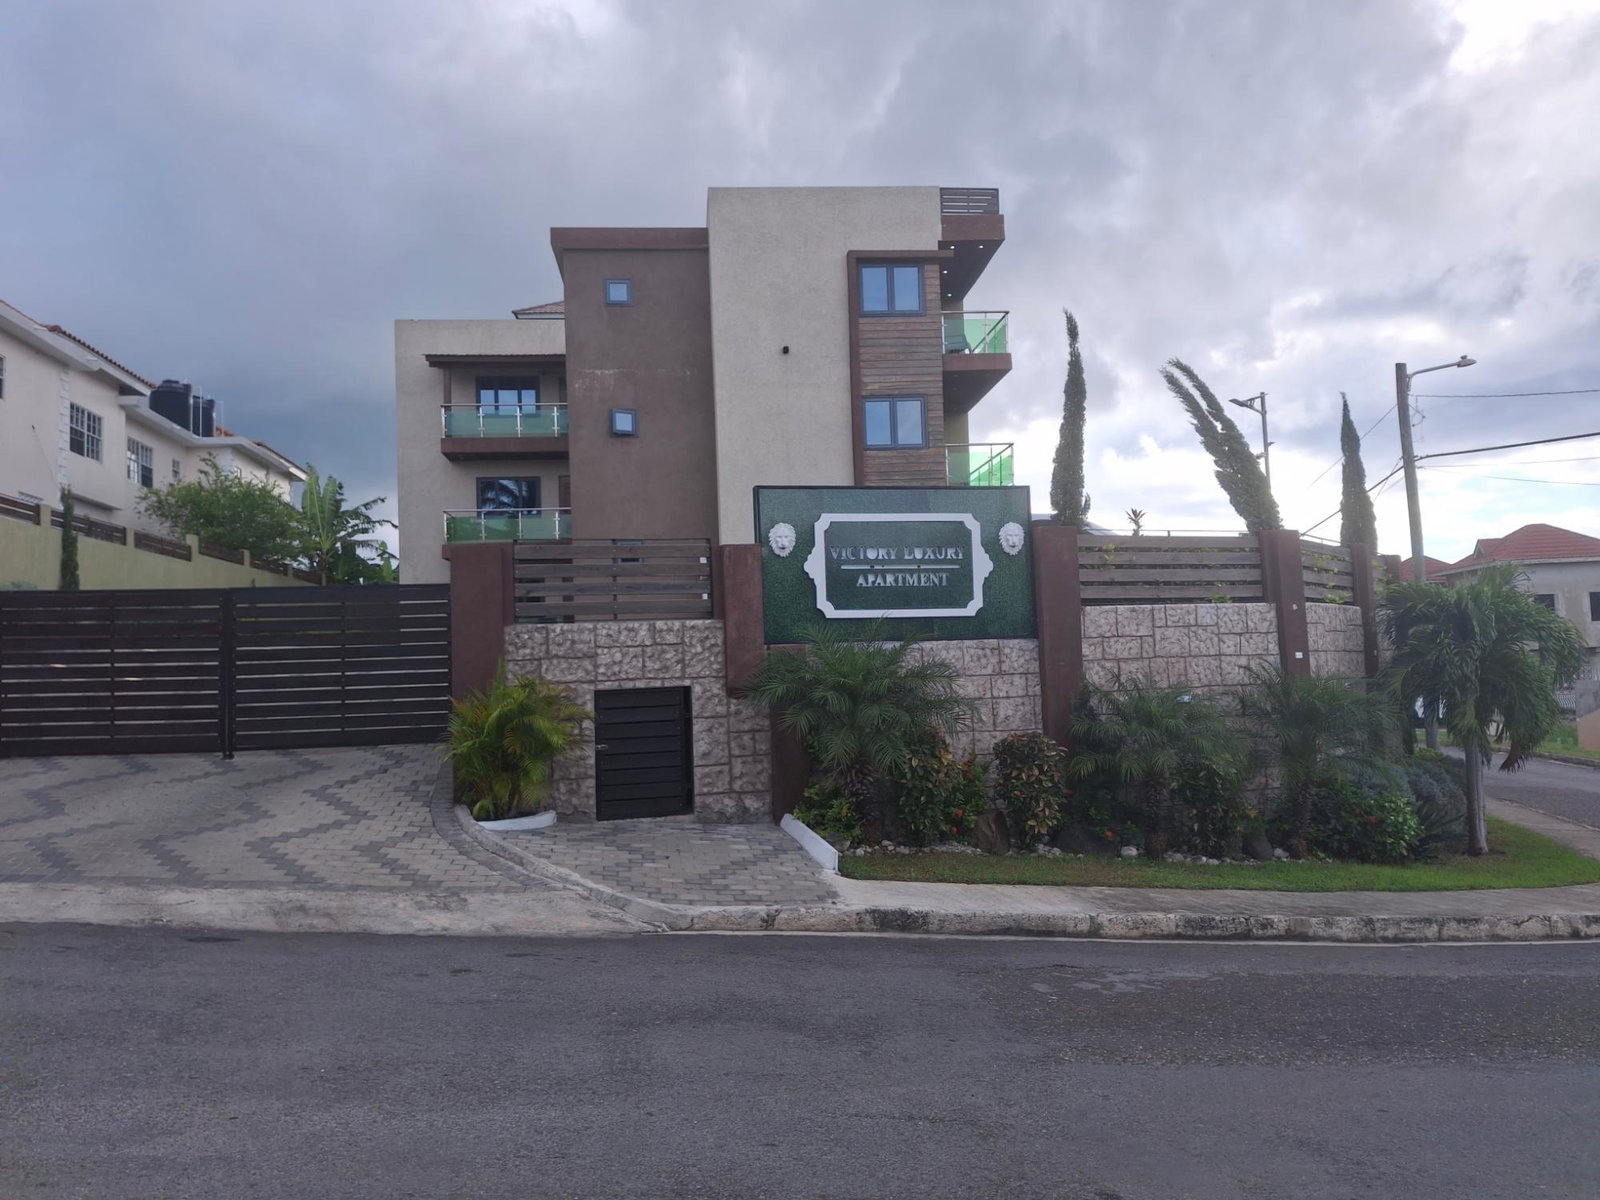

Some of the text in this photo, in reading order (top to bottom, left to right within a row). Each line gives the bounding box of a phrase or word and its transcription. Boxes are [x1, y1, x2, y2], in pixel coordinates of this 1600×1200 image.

[829, 545, 965, 560] VICTORY LUXURY
[856, 573, 949, 587] APARTMENT
